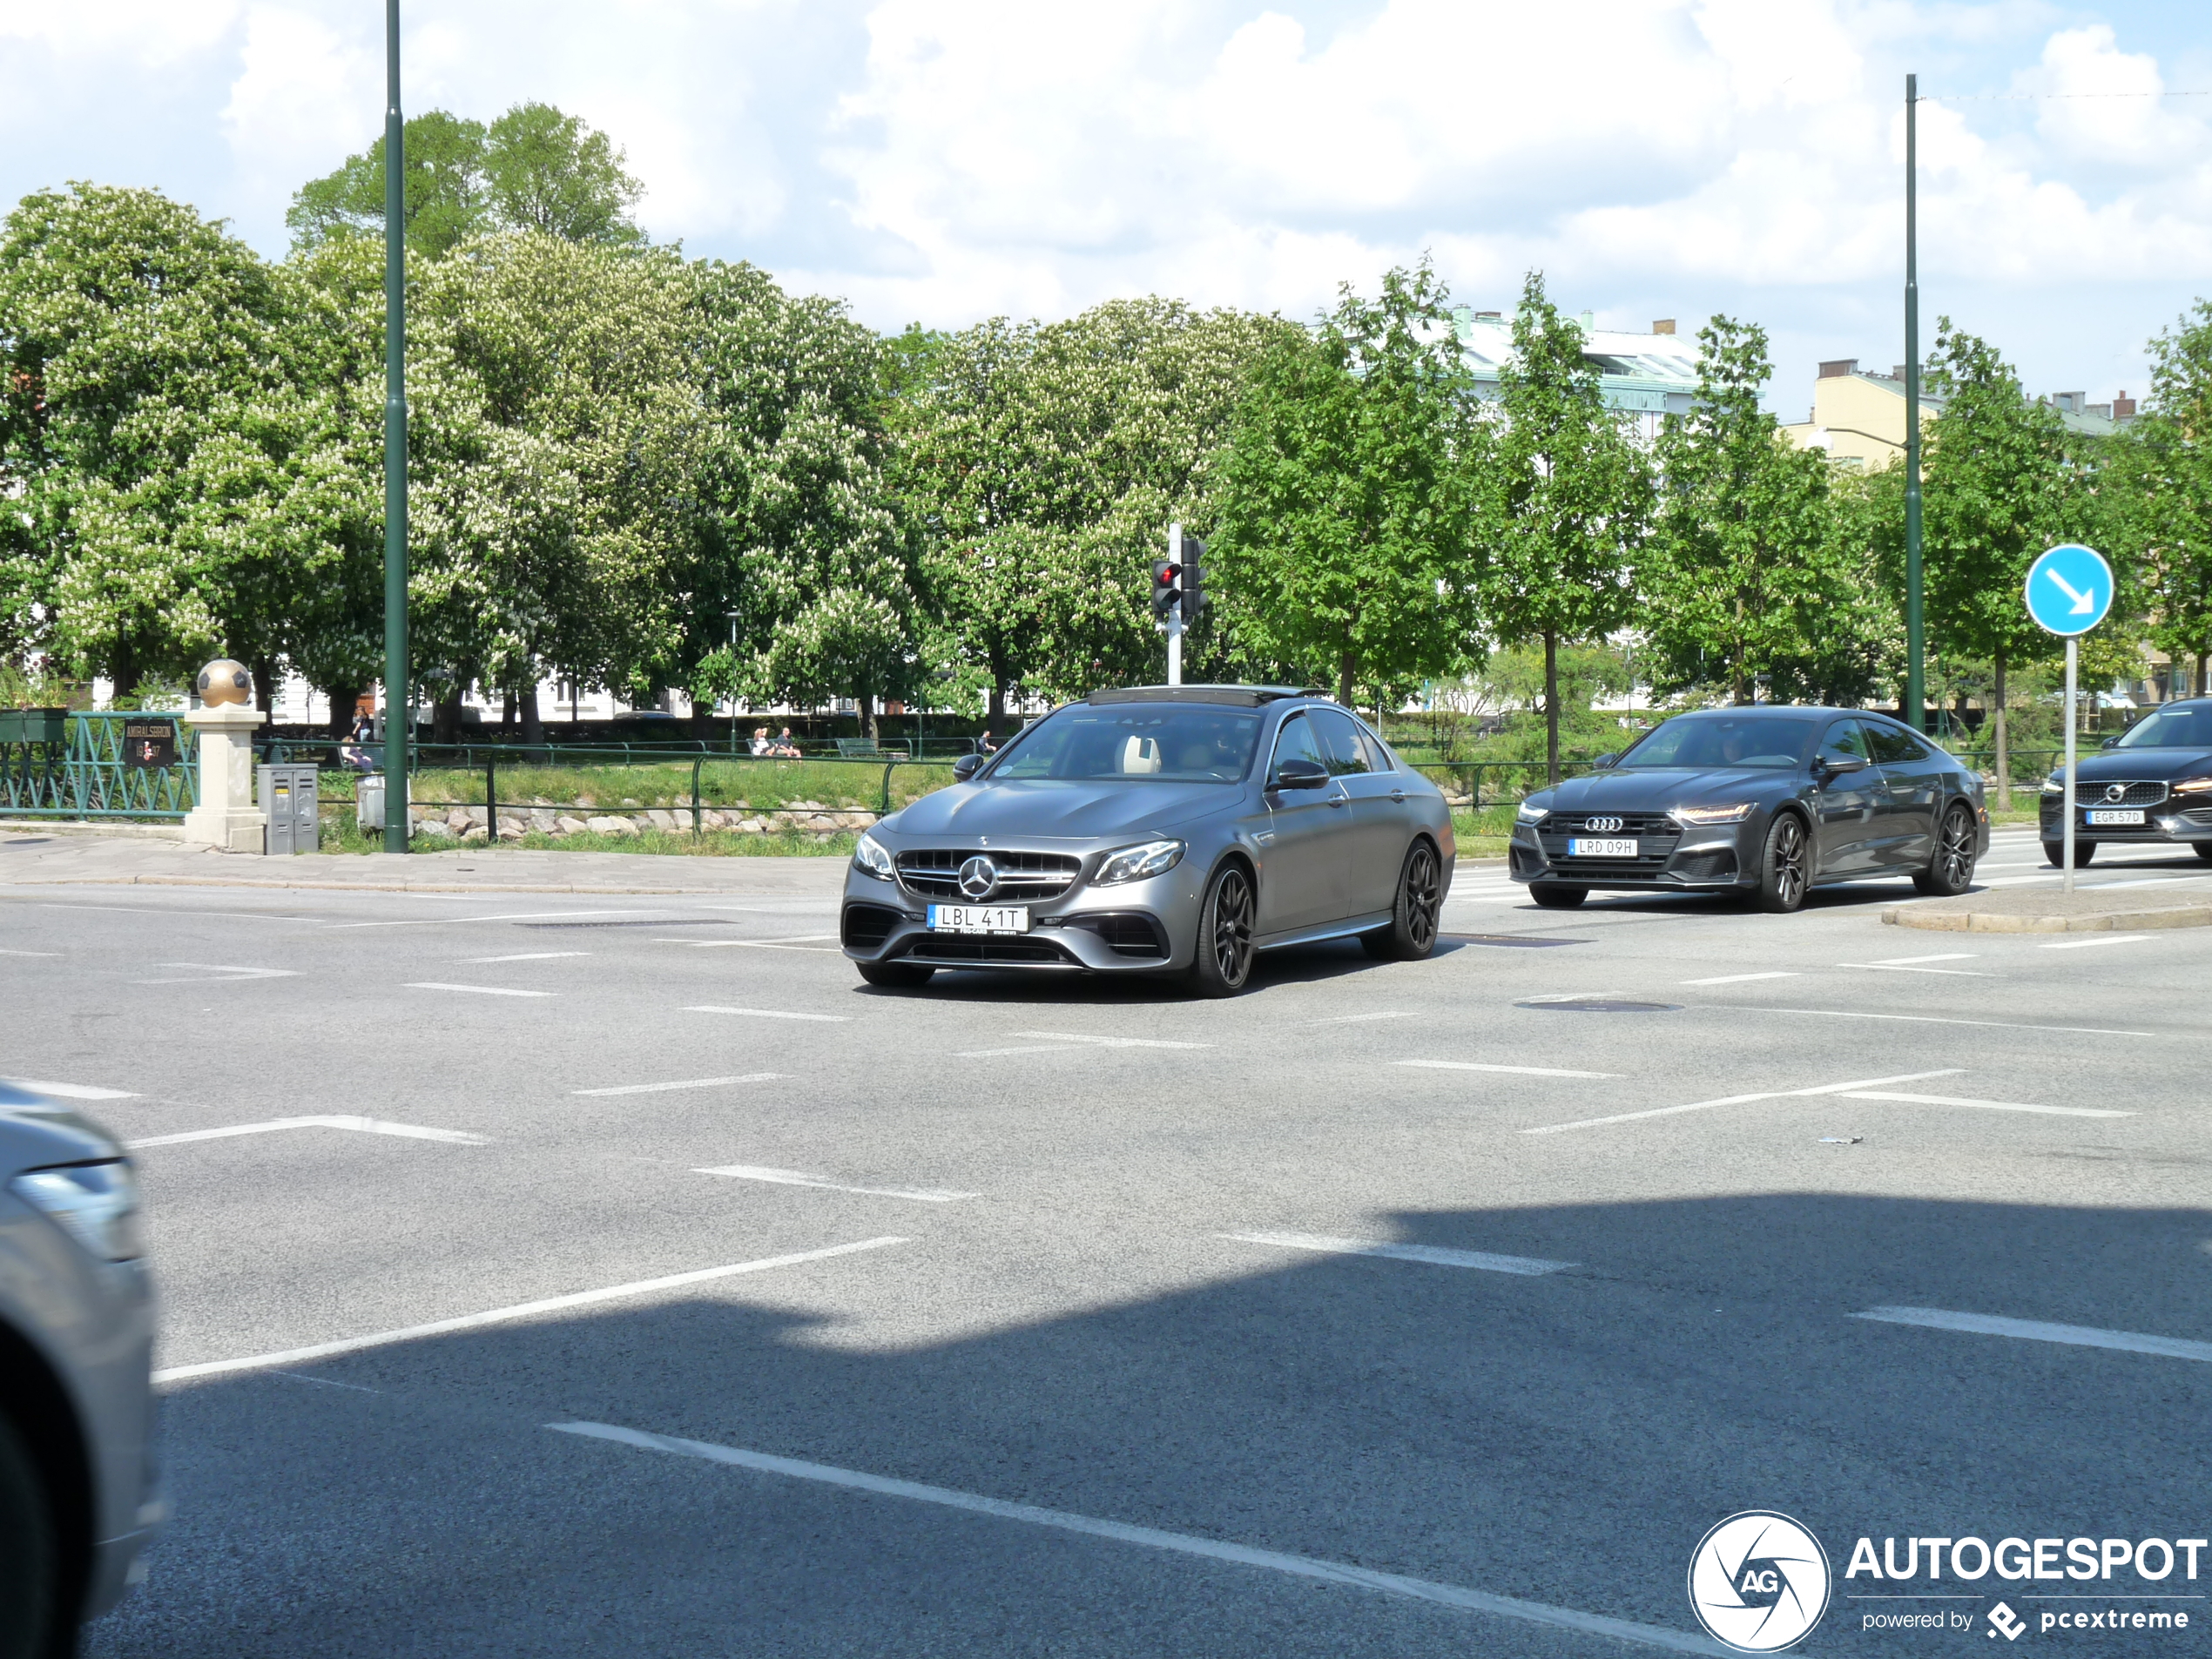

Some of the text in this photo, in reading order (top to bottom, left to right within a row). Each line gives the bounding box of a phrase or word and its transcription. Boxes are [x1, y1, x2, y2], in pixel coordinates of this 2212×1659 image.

[126, 725, 171, 738] AMIRALSBRON
[2094, 812, 2115, 822] EGR
[1579, 840, 1632, 853] LRD 09H
[942, 907, 1018, 927] LBL 41T
